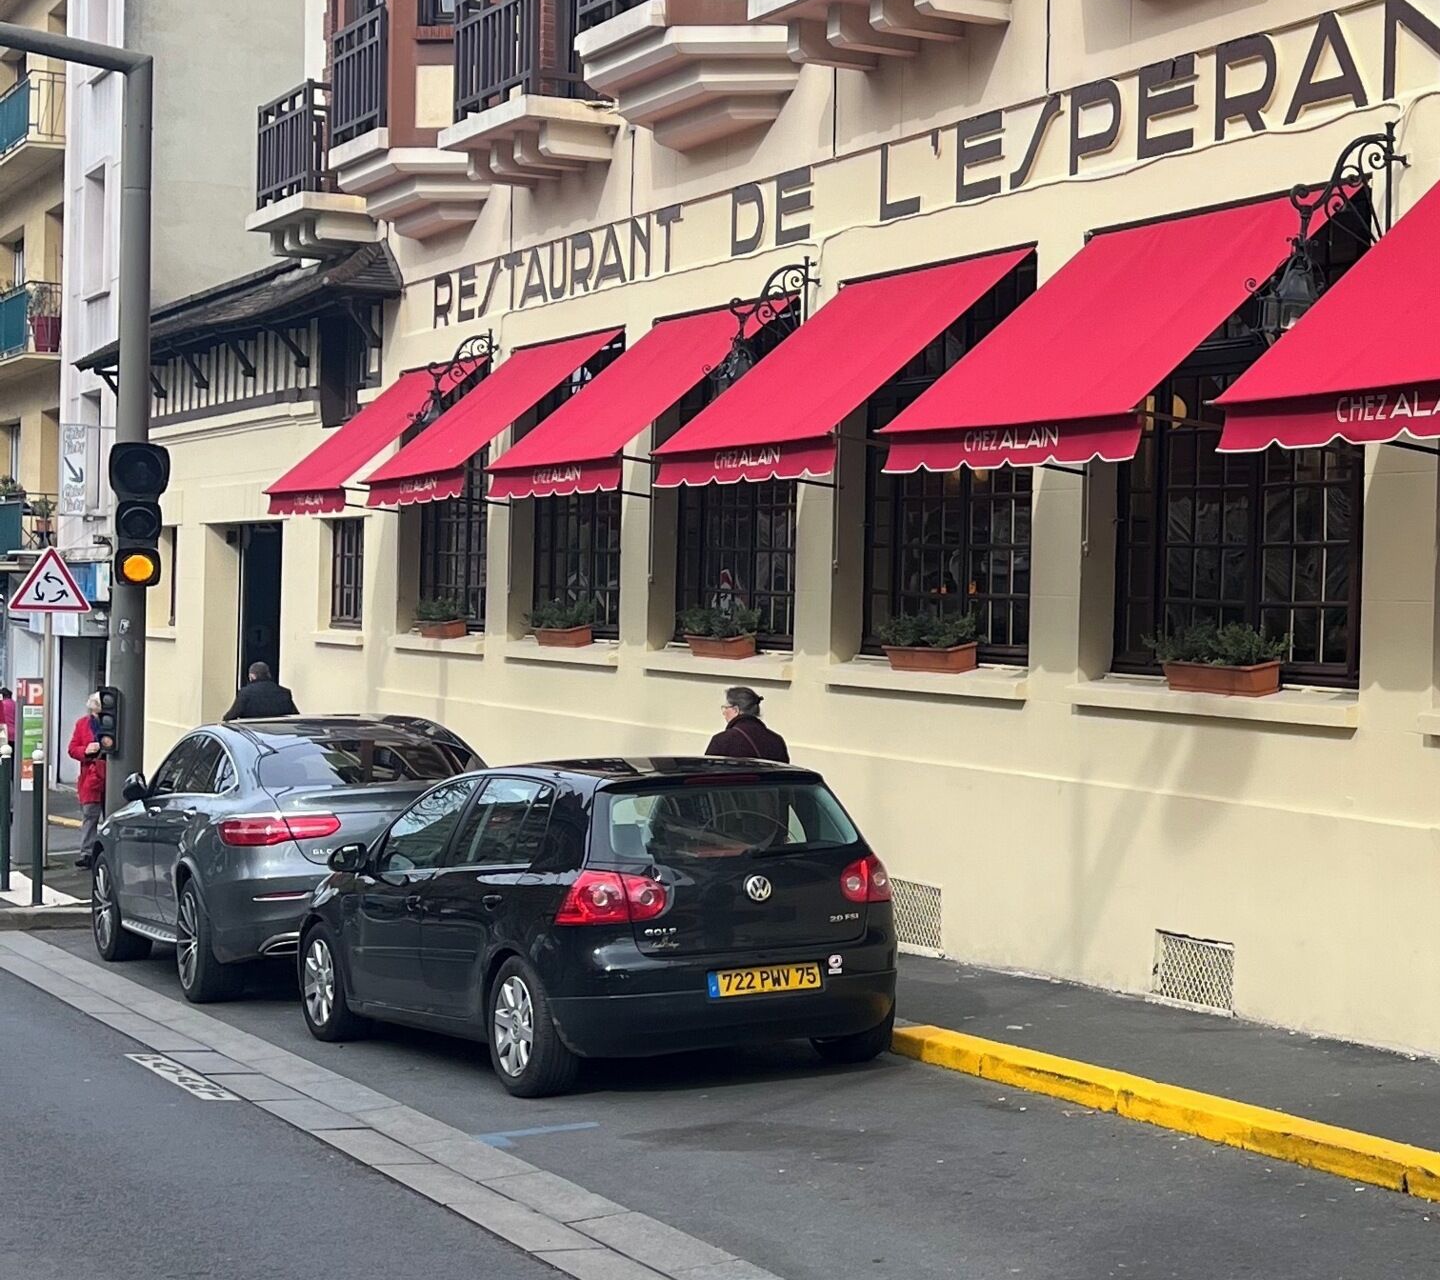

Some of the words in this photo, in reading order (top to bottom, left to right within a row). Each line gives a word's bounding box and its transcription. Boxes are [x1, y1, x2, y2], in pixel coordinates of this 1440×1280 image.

[433, 204, 684, 329] RESTAURANT
[731, 166, 813, 257] DE
[1335, 394, 1387, 423] CHEZ
[963, 430, 998, 452] CHEZ
[999, 426, 1060, 450] ALAIN
[714, 450, 738, 470] CHEZ
[737, 446, 781, 467] ALAIN
[644, 927, 677, 937] GOLF
[722, 972, 756, 992] 722
[759, 968, 791, 989] PWV
[795, 966, 817, 985] 75
